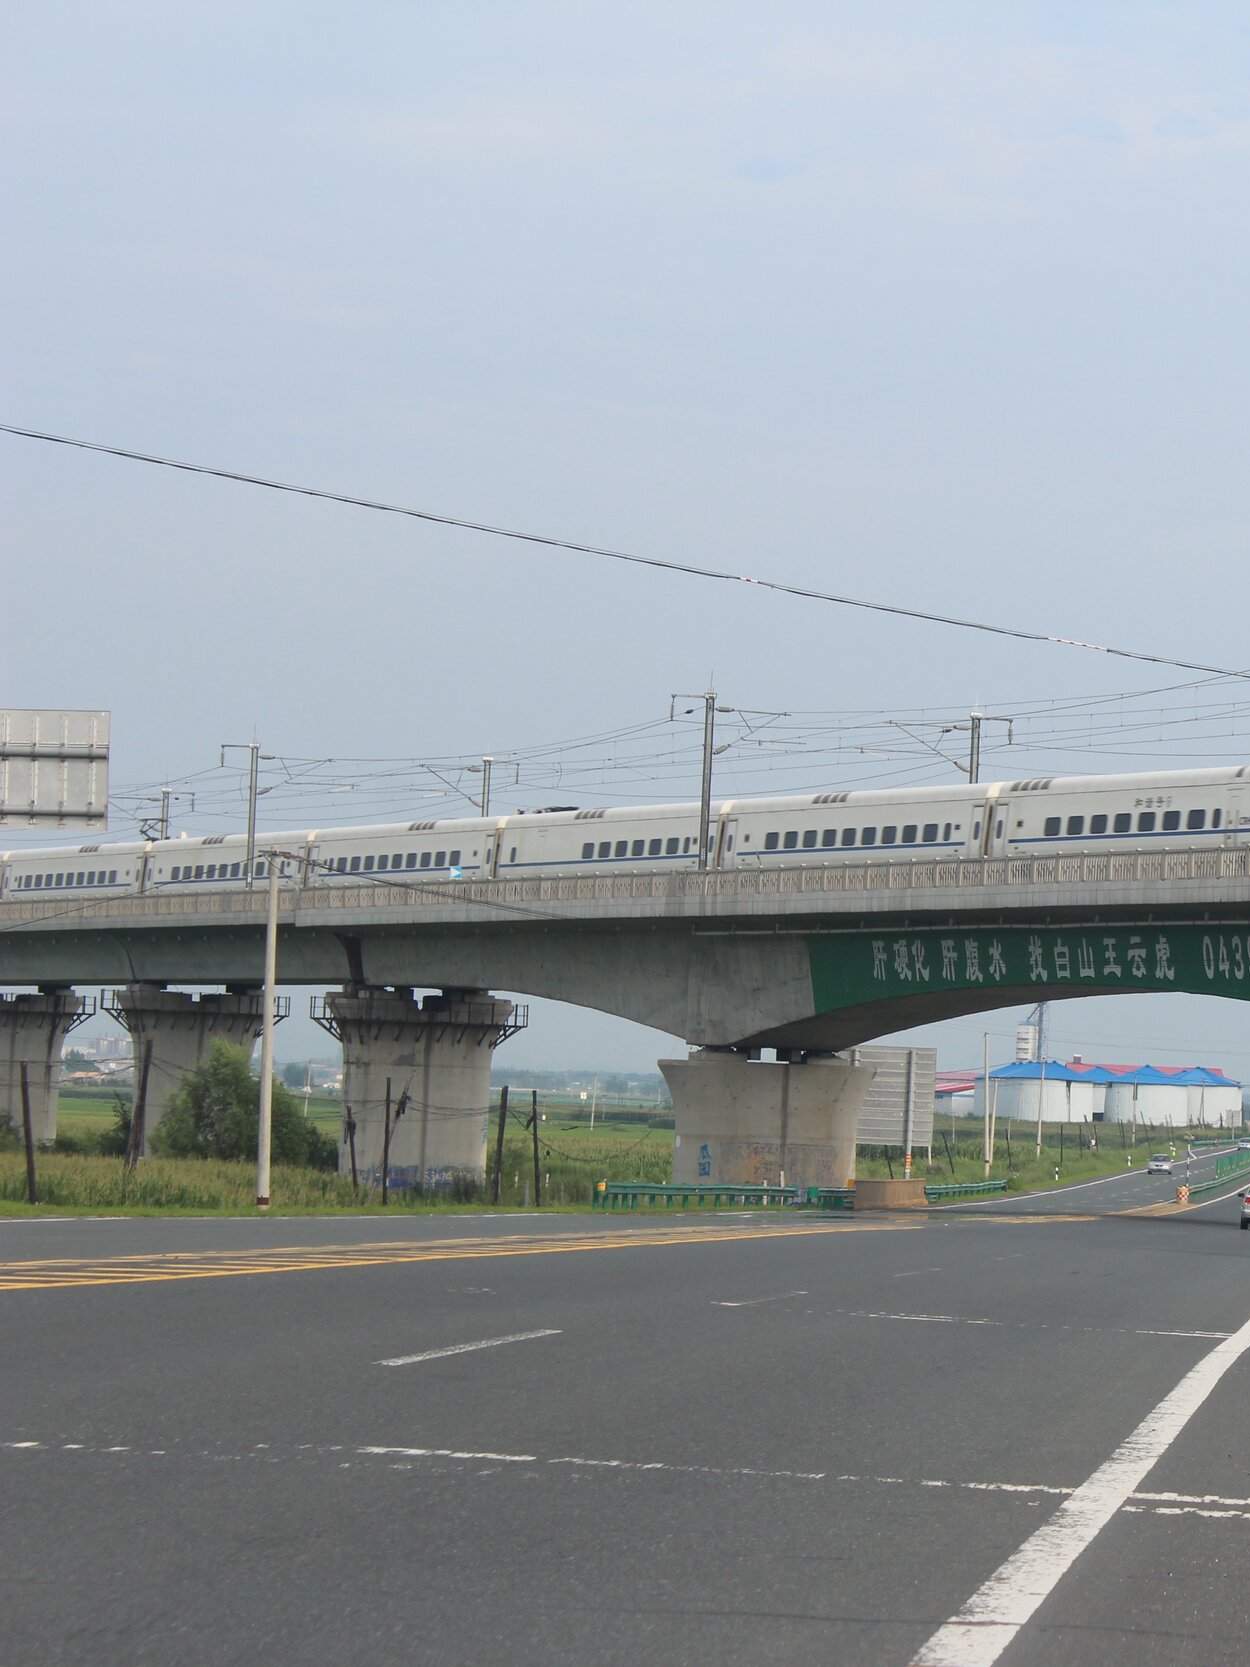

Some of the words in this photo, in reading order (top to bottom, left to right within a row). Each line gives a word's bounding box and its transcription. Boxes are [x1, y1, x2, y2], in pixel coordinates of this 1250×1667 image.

[872, 939, 930, 982] 肝硬化
[941, 937, 1006, 983] 肝腹水
[1028, 934, 1175, 982] 找白山王云虎
